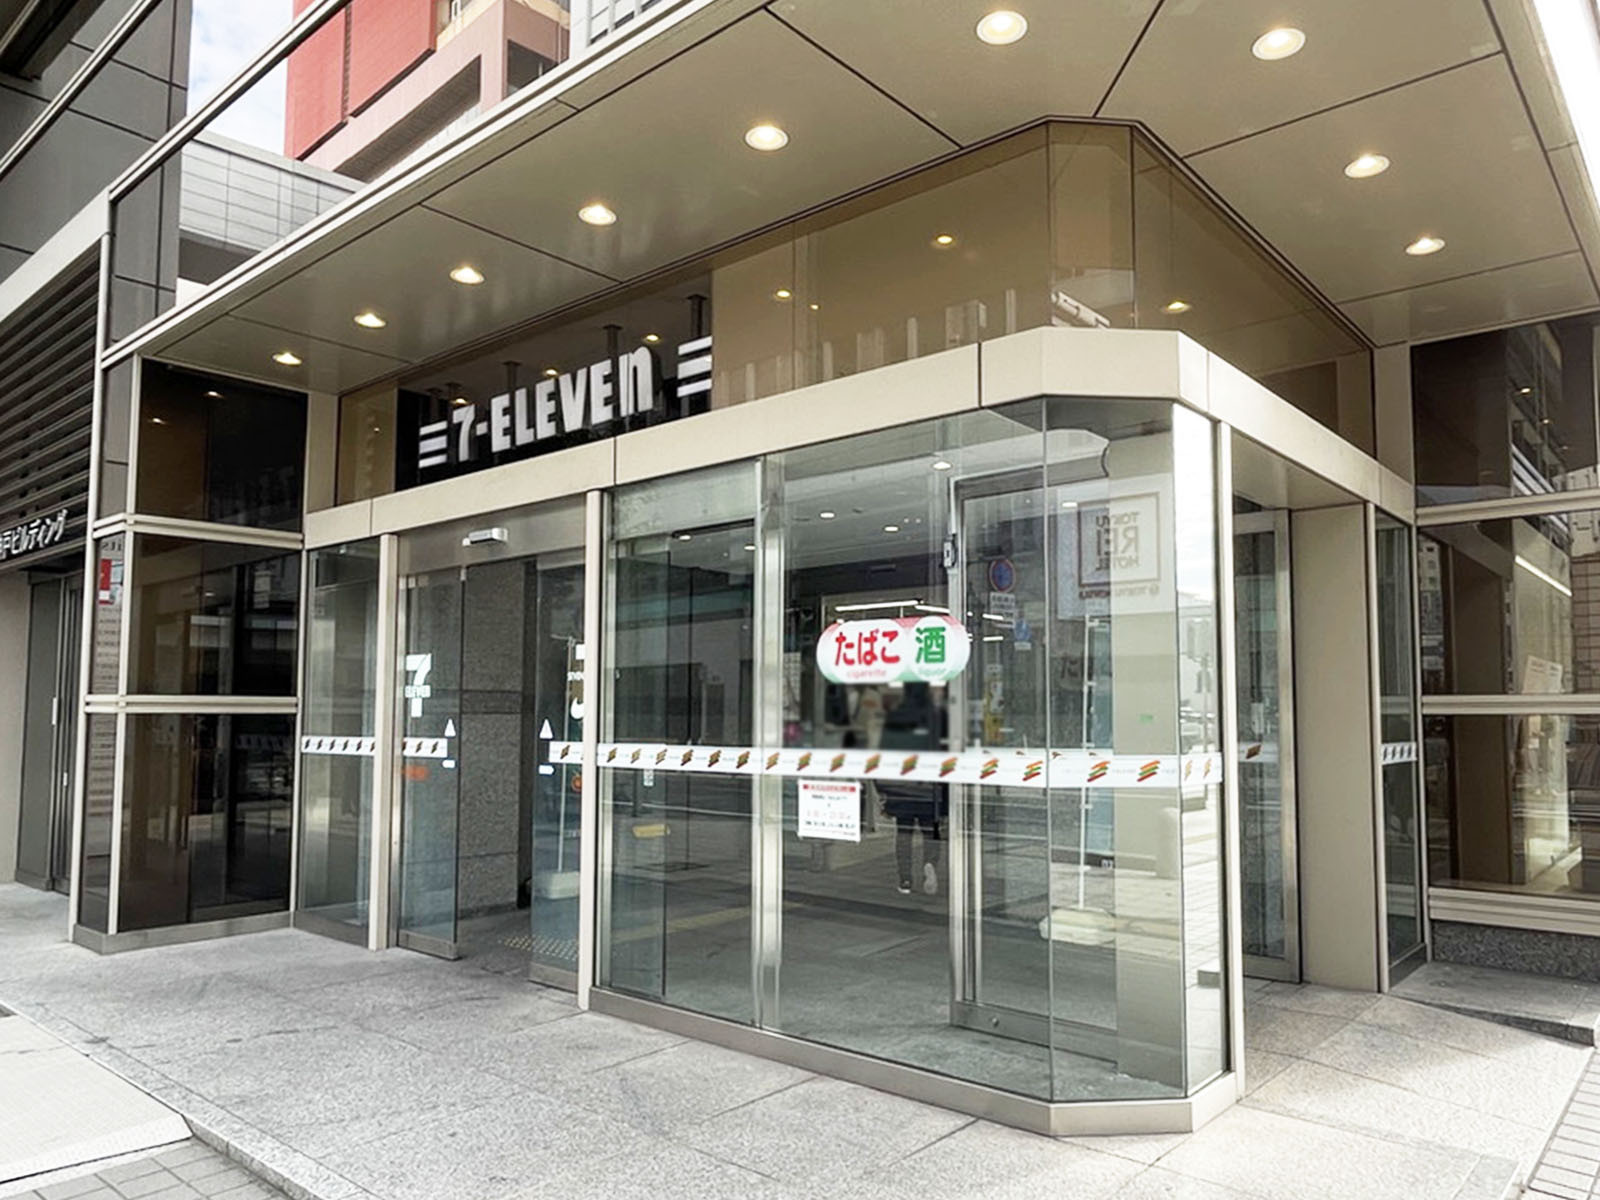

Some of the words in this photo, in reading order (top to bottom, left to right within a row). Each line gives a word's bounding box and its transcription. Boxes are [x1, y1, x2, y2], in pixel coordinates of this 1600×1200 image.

[0, 509, 68, 560] 戸ビルディング
[835, 629, 901, 666] たばこ
[915, 626, 946, 664] 酒
